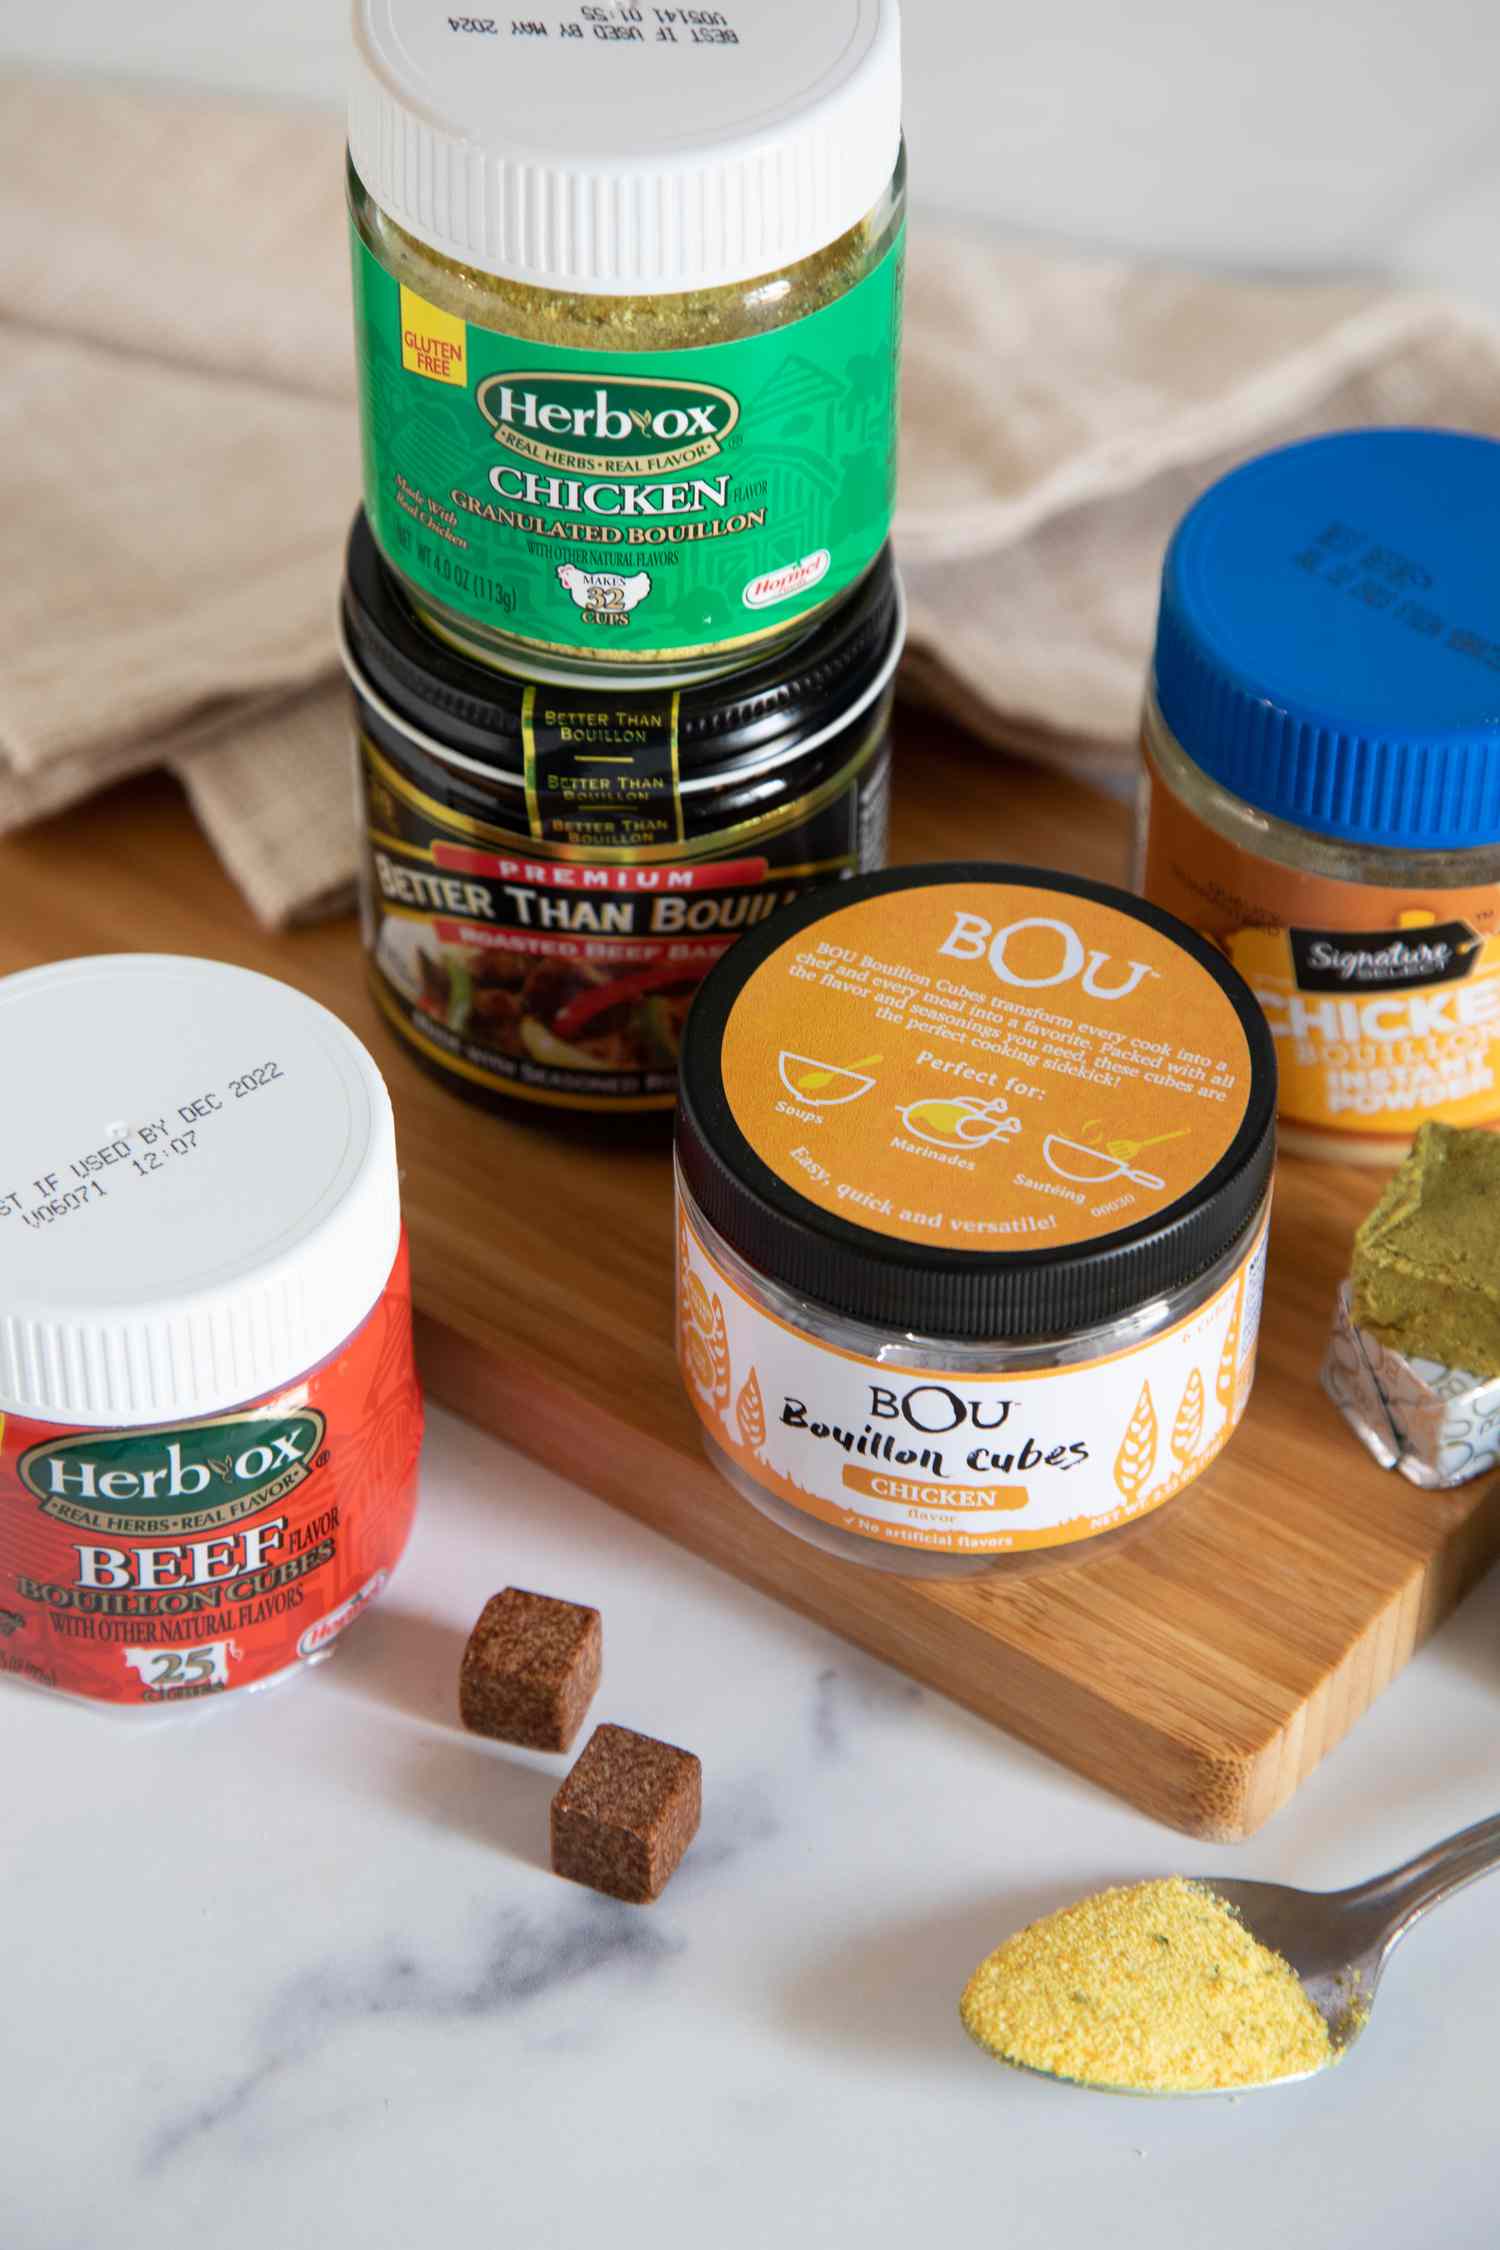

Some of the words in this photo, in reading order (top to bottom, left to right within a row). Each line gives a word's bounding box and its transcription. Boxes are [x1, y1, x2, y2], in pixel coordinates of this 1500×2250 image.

[448, 17, 497, 34] 2024
[511, 20, 548, 37] MAY
[560, 22, 583, 38] BY
[593, 25, 643, 41] USED
[656, 27, 678, 43] IF
[692, 27, 739, 44] BEST
[404, 330, 462, 362] GLUTEN
[418, 351, 450, 377] FREE
[505, 432, 541, 457] REAL
[544, 450, 594, 471] HERBS
[605, 460, 643, 473] REAL
[648, 446, 706, 471] FLAVOR
[488, 465, 732, 517] CHICKEN
[733, 480, 768, 502] FLAVOR
[450, 489, 624, 545] GRANULATED
[627, 508, 767, 545] BOUILLON
[527, 540, 553, 557] WITH
[554, 545, 588, 564] OTHER
[588, 549, 633, 567] NATURAL
[635, 551, 680, 567] FLAVORS
[454, 562, 470, 592] OZ
[582, 574, 627, 588] MAKES
[586, 586, 625, 611] 32
[581, 610, 630, 626] CUPS
[498, 858, 696, 888] PREMIUM
[937, 911, 1152, 1001] BOU
[1308, 940, 1453, 981] Signature
[794, 951, 837, 971] chef
[836, 962, 870, 983] and
[871, 976, 920, 998] every
[923, 989, 967, 1012] meal
[969, 1005, 1004, 1024] into
[1007, 1018, 1019, 1029] a
[1023, 1019, 1094, 1051] favorite.
[1099, 1041, 1164, 1070] Packed
[1166, 1060, 1207, 1082] with
[1210, 1072, 1236, 1089] all
[816, 942, 858, 964] BOU
[859, 954, 931, 987] Bouillon
[935, 978, 987, 1005] Cubes
[991, 996, 1073, 1029] transform
[1078, 1023, 1127, 1045] every
[1130, 1036, 1172, 1057] cook
[1177, 1047, 1213, 1068] into
[1216, 1061, 1228, 1073] a
[788, 963, 818, 982] the
[820, 972, 871, 999] flavor
[873, 990, 908, 1011] and
[909, 1002, 1002, 1040] seasonings
[1006, 1031, 1038, 1050] you
[1041, 1041, 1087, 1063] need,
[1093, 1055, 1142, 1078] these
[1142, 1070, 1195, 1094] cubes
[1197, 1086, 1227, 1102] are
[874, 1006, 905, 1025] the
[904, 1016, 967, 1045] perfect
[970, 1036, 1041, 1069] cooking
[1042, 1056, 1121, 1089] sidekick!
[915, 1049, 999, 1088] Perfect
[1002, 1076, 1047, 1101] for:
[33, 1172, 59, 1198] IF
[70, 1139, 132, 1180] USED
[137, 1118, 170, 1145] BY
[177, 1092, 224, 1124] DEC
[228, 1061, 285, 1099] 2022
[774, 1099, 825, 1126] Soups
[131, 1129, 200, 1178] 12:07
[889, 1135, 977, 1172] Marinades
[788, 1144, 831, 1187] Easy,
[836, 1181, 893, 1217] quick
[898, 1207, 943, 1229] and
[948, 1212, 1058, 1235] versatile!
[1011, 1172, 1087, 1207] Sautéing
[867, 1384, 1014, 1434] BOU
[779, 1395, 952, 1479] Bouillon
[57, 1502, 100, 1528] REAL
[107, 1517, 170, 1532] HERBS
[180, 1512, 227, 1531] REAL
[229, 1474, 297, 1517] FLAVOR
[869, 1475, 999, 1508] CHICKEN
[856, 1517, 881, 1534] No
[884, 1524, 954, 1547] artificial
[956, 1533, 1015, 1548] flavors
[905, 1507, 959, 1525] flavor
[72, 1515, 289, 1591] BEEF
[288, 1505, 341, 1554] FLAVOR
[14, 1575, 221, 1617] BOUILLON
[222, 1537, 337, 1603] CUBES
[49, 1612, 96, 1641] WITH
[97, 1616, 158, 1646] OTHER
[159, 1607, 237, 1644] NATURAL
[239, 1581, 305, 1627] FLAVORS
[150, 1646, 216, 1686] 25
